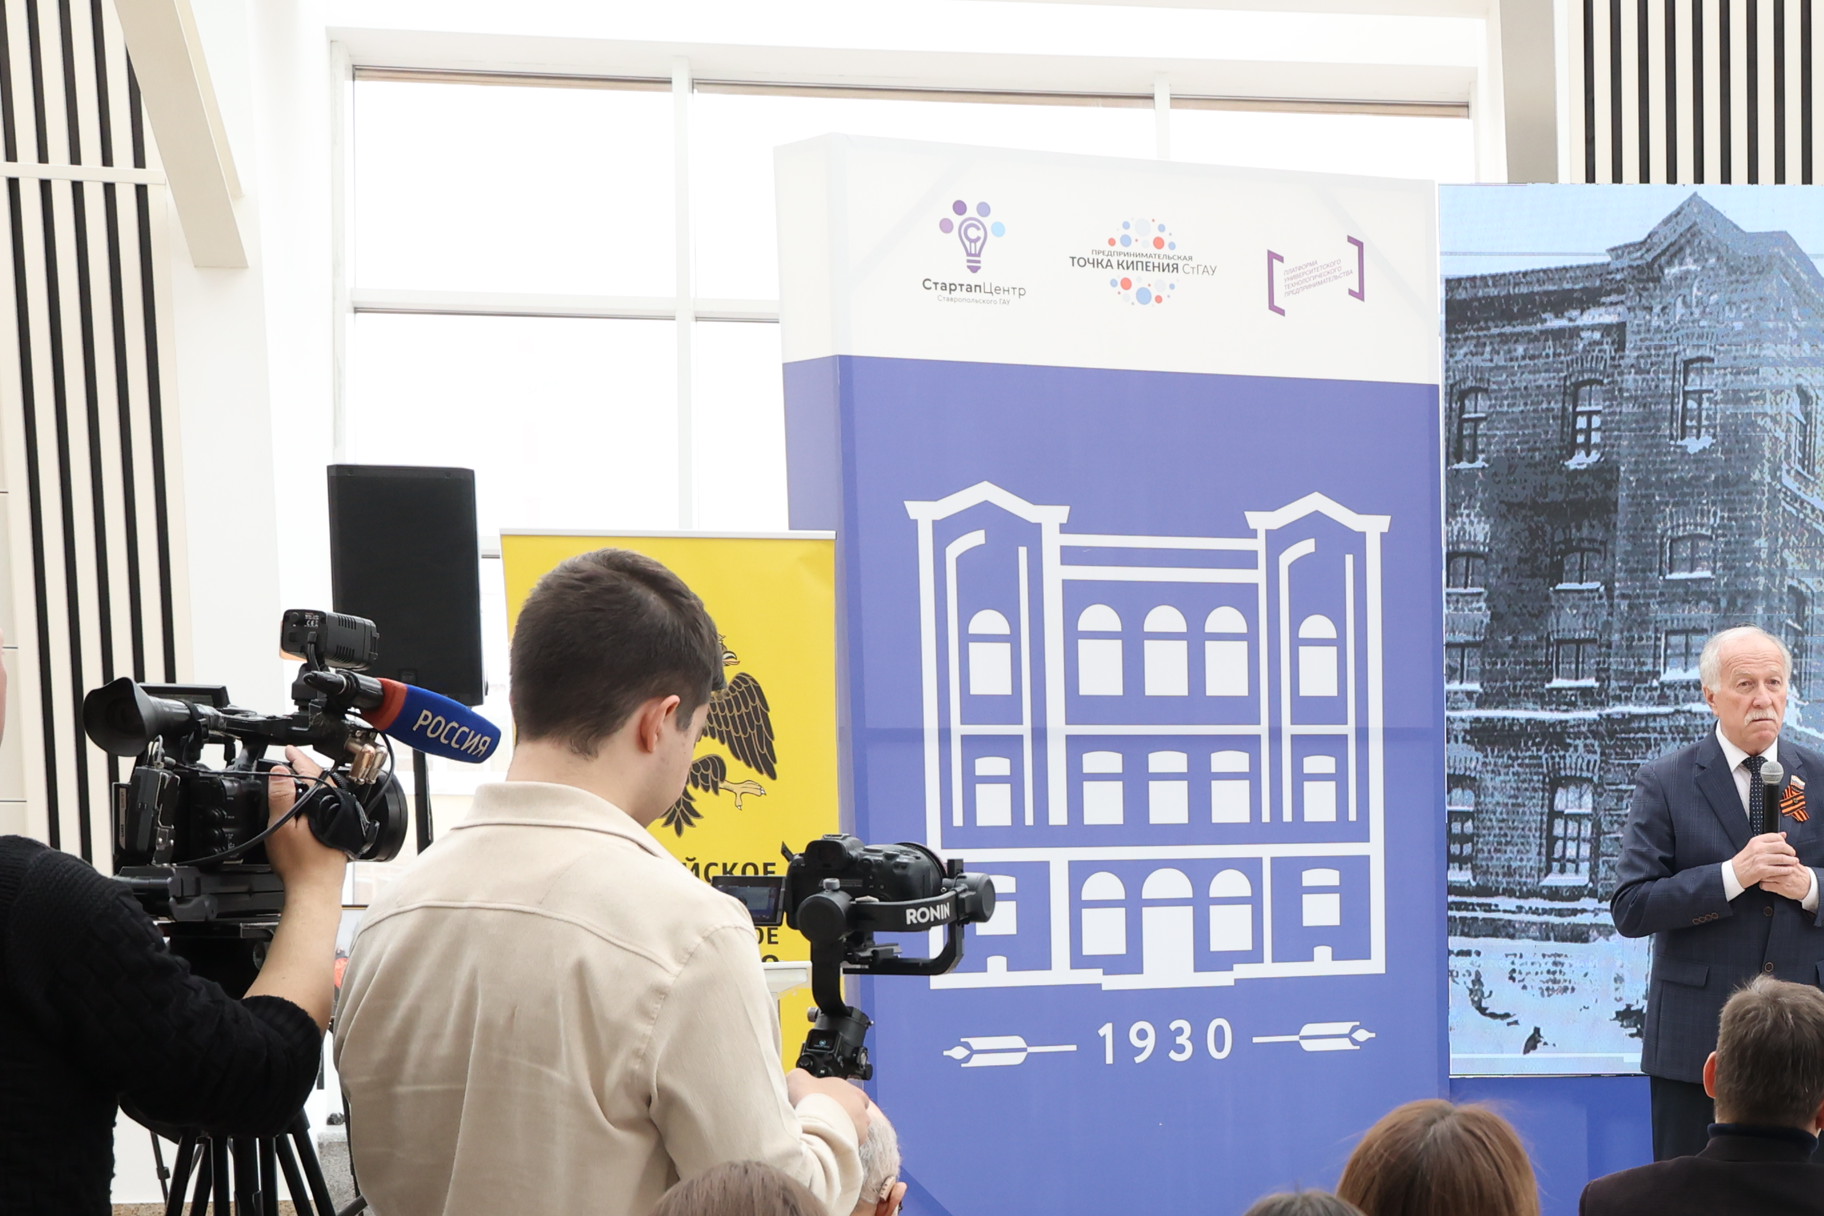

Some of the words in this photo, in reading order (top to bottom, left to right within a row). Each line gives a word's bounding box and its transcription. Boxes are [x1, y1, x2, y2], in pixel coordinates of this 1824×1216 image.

[1090, 249, 1193, 262] ПРЕДПРИНИМАТЕЛЬСКАЯ
[1069, 256, 1114, 270] ТОЧКА
[1117, 259, 1179, 274] КИПЕНИЯ
[1182, 263, 1218, 277] СтГАУ
[922, 278, 1026, 299] СтартапЦентр
[937, 294, 998, 305] Ставропольского
[412, 709, 492, 758] РОССИЯ
[905, 902, 950, 925] RONIN
[1097, 1017, 1233, 1064] 1930
